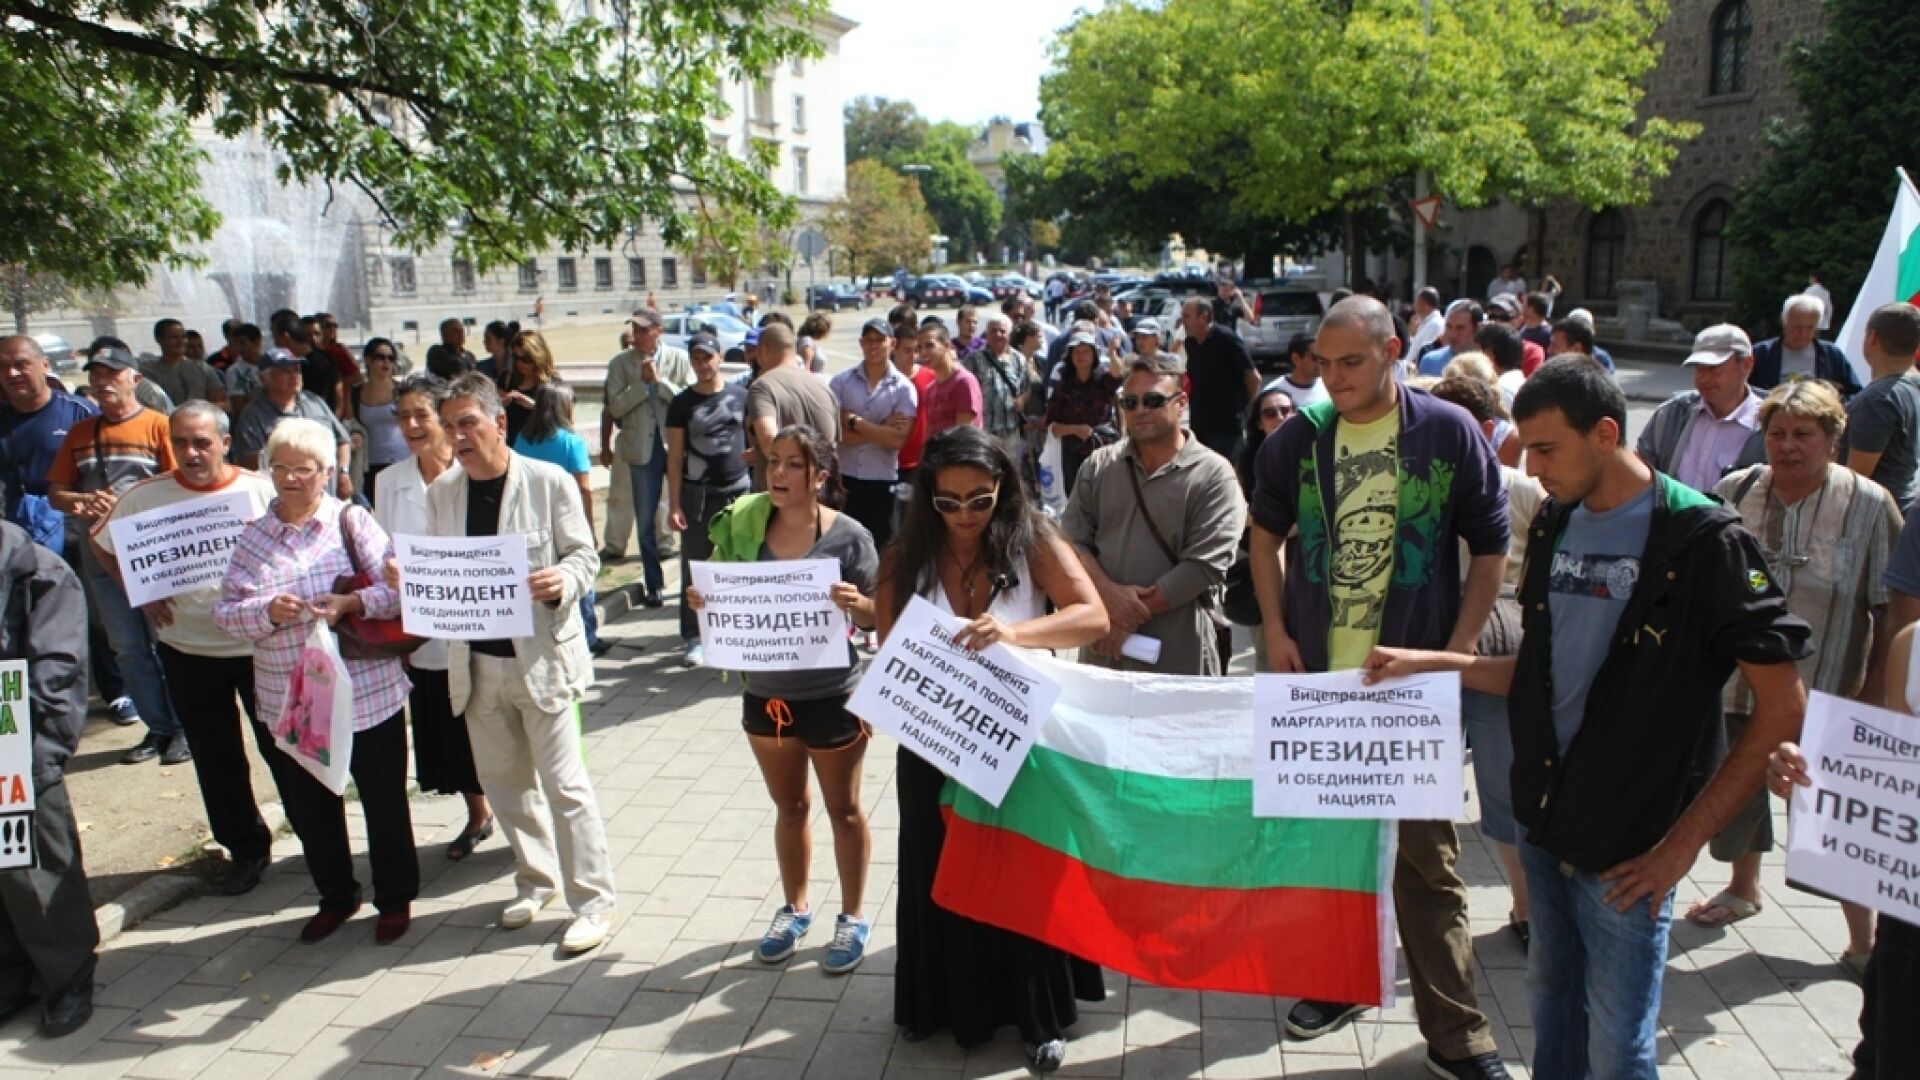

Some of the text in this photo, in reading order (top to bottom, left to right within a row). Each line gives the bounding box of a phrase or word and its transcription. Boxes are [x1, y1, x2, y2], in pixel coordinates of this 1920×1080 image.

[127, 518, 244, 552] МАРГАРИТА ПОПОВА
[405, 565, 515, 578] МАРГАРИТА ПОПОВА
[714, 573, 813, 585] Вицепрезидента
[405, 582, 518, 604] ПРЕЗИДЕНТ
[704, 592, 829, 604] МАРГАРИТА ПОПОВА
[496, 607, 514, 616] НА
[433, 622, 486, 632] НАЦИЯТА
[706, 610, 832, 632] ПРЕЗИДЕНТ
[725, 637, 804, 648] ОБЕДИНИТЕЛ
[810, 635, 829, 645] НА
[742, 652, 800, 663] НАЦИЯТА
[902, 637, 1029, 725] МАРГАРИТА ПОПОВА
[1290, 688, 1423, 703] Вицепрезидента
[884, 656, 1021, 752] ПРЕЗИДЕНТ
[879, 685, 999, 770] И ОБЕДИНИТЕЛ НА
[1271, 714, 1441, 728] МАРГАРИТА ПОПОВА
[900, 721, 961, 767] НАЦИЯТА
[1270, 739, 1445, 766] ПРЕЗИДЕНТ
[1278, 773, 1437, 787] И ОБЕДИНИТЕЛ НА
[1318, 793, 1396, 808] НАЦИЯТА
[1815, 787, 1920, 844] ПРЕЗ
[1822, 833, 1837, 852] И
